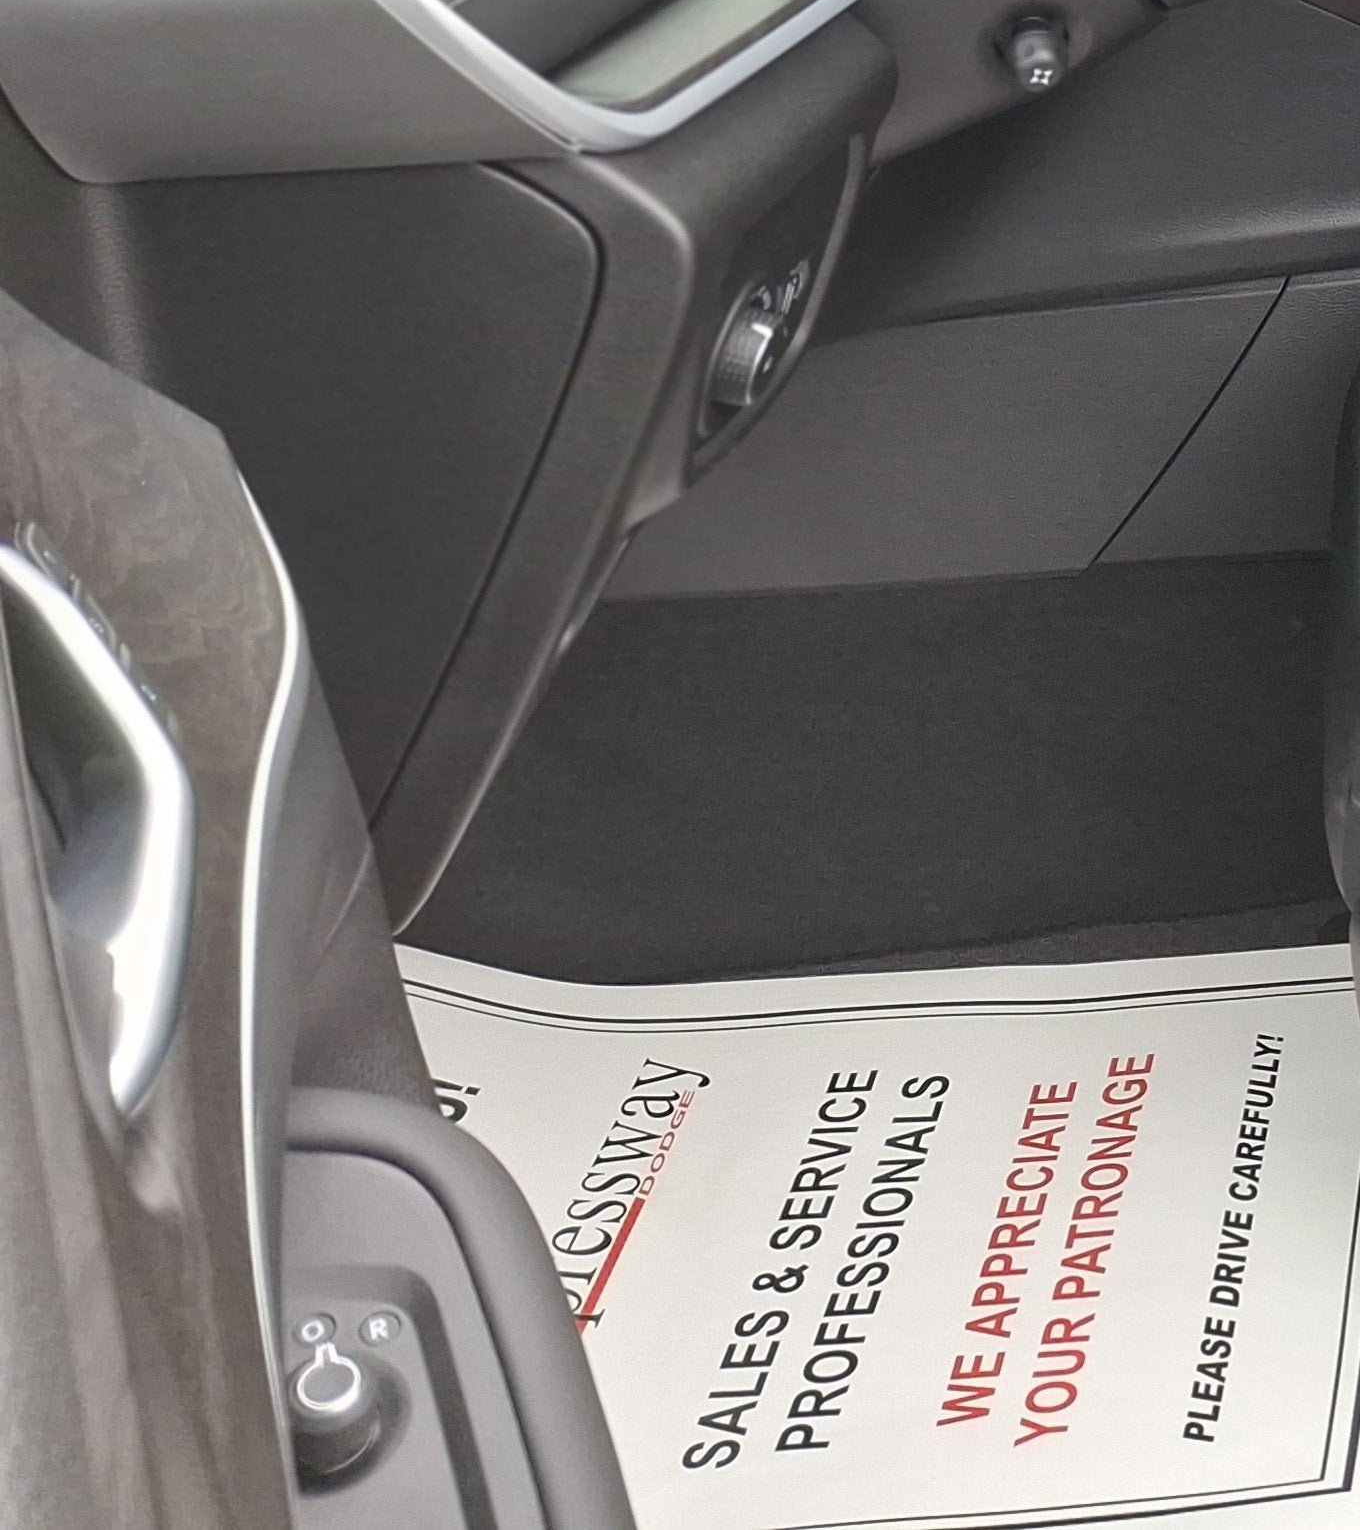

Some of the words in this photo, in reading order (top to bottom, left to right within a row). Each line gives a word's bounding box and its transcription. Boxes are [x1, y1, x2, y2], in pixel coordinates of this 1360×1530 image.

[638, 1089, 696, 1196] DODGE
[769, 1069, 879, 1251] SERVICE
[1052, 1053, 1155, 1301] PATRONAGE
[1228, 1033, 1283, 1201] CAREFULLY!
[774, 1075, 950, 1452] PROFESSIONALS
[964, 1081, 1078, 1339] APPRECIATE
[1209, 1210, 1254, 1308] DRIVE
[369, 1318, 389, 1341] R
[751, 1264, 809, 1294] &
[682, 1310, 790, 1469] SALES
[936, 1351, 1006, 1427] WE
[1013, 1313, 1096, 1447] YOUR
[1182, 1316, 1236, 1443] PLEASE
